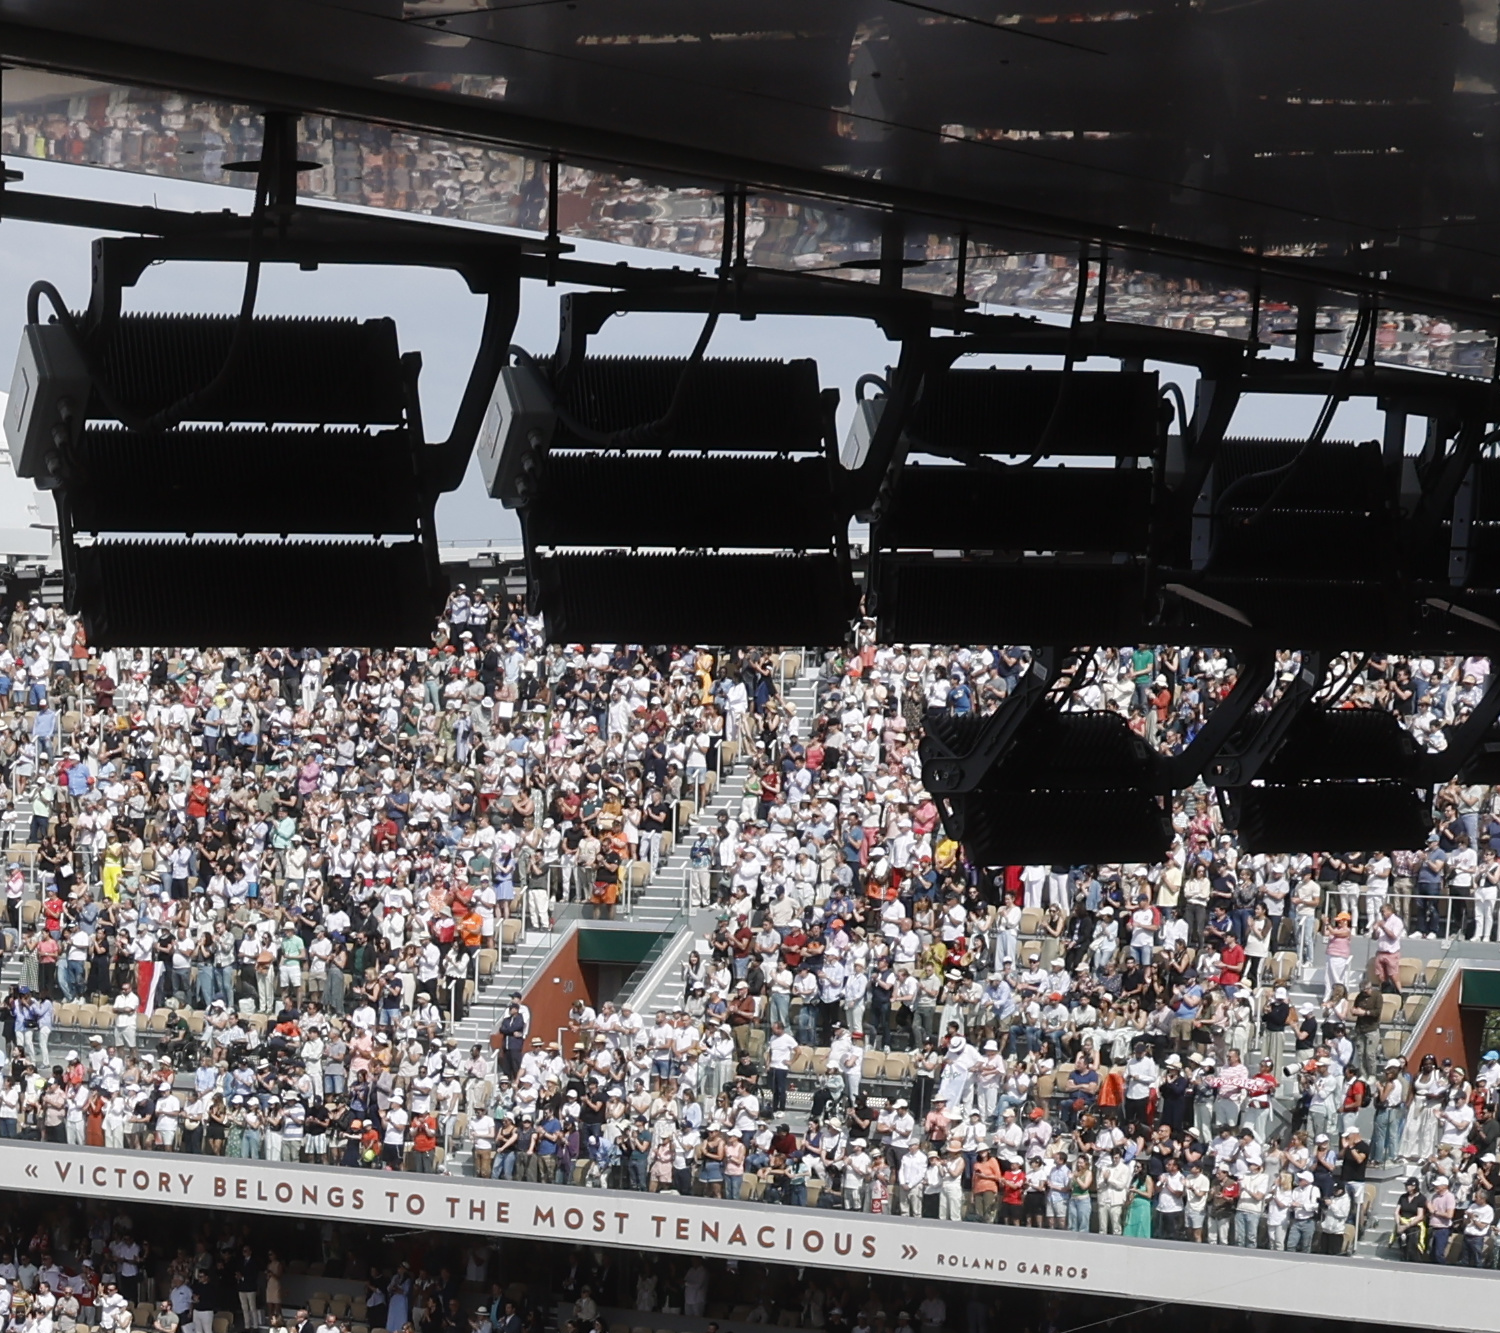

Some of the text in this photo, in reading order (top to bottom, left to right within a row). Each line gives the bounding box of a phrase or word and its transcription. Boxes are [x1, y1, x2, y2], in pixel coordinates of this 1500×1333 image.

[54, 1161, 194, 1194] VICTORY
[214, 1177, 364, 1210] BELONGS
[385, 1191, 426, 1215] TO
[446, 1197, 510, 1223] THE
[533, 1206, 630, 1234] MOST
[651, 1215, 877, 1258] TENACIOUS
[937, 1253, 1008, 1272] ROLAND
[1017, 1261, 1089, 1279] GARROS
